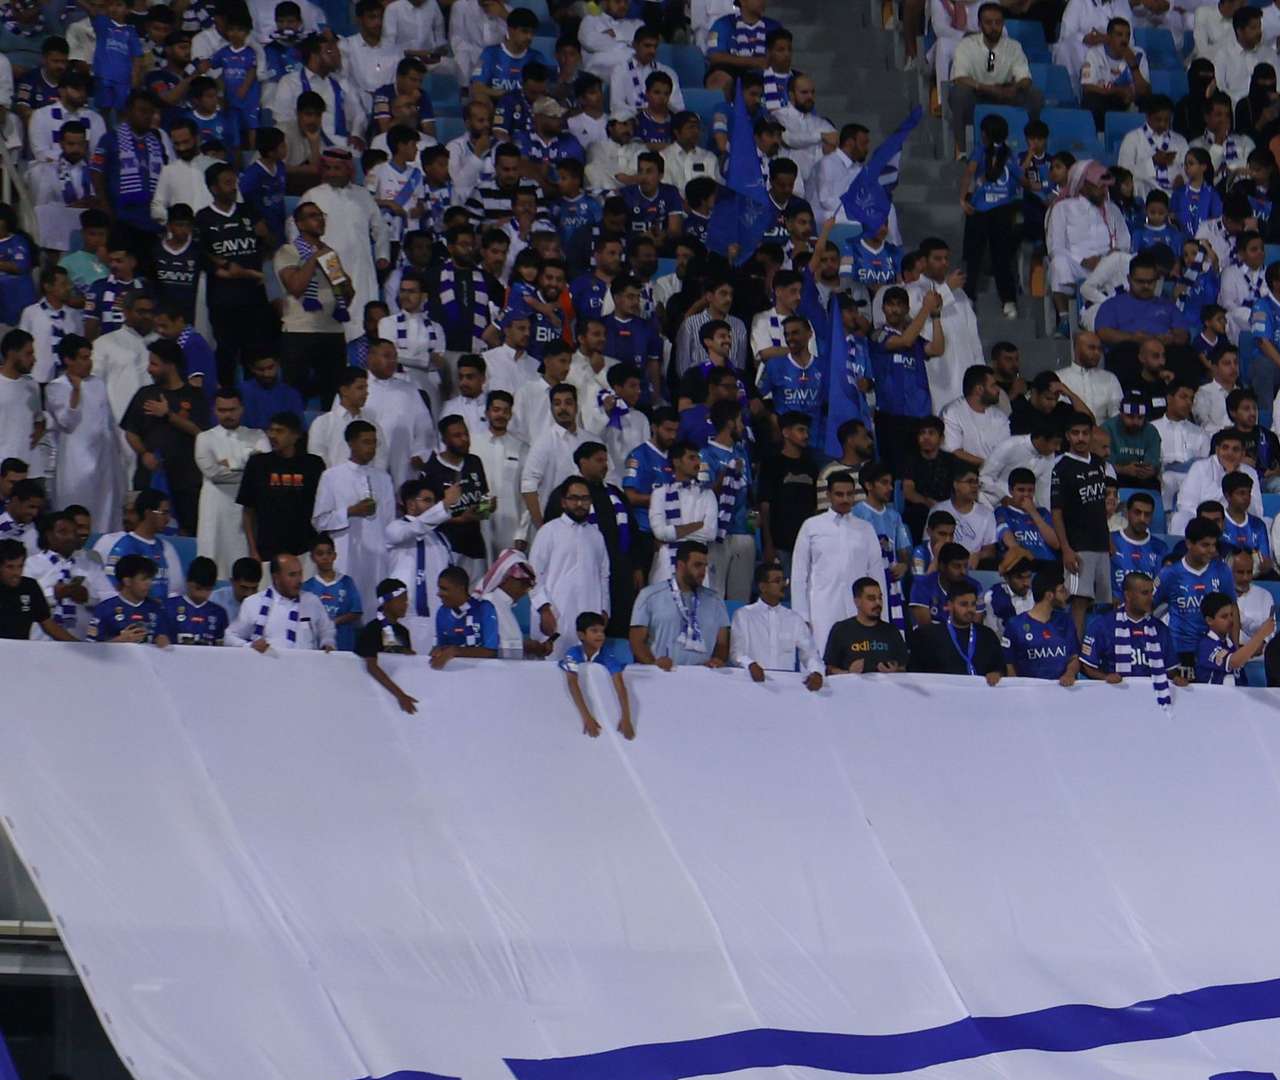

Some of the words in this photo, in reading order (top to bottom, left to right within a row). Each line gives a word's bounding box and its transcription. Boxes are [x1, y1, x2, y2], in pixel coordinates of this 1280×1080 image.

[212, 238, 257, 254] SAVVY
[1177, 595, 1204, 608] SAV
[851, 639, 890, 653] adidas
